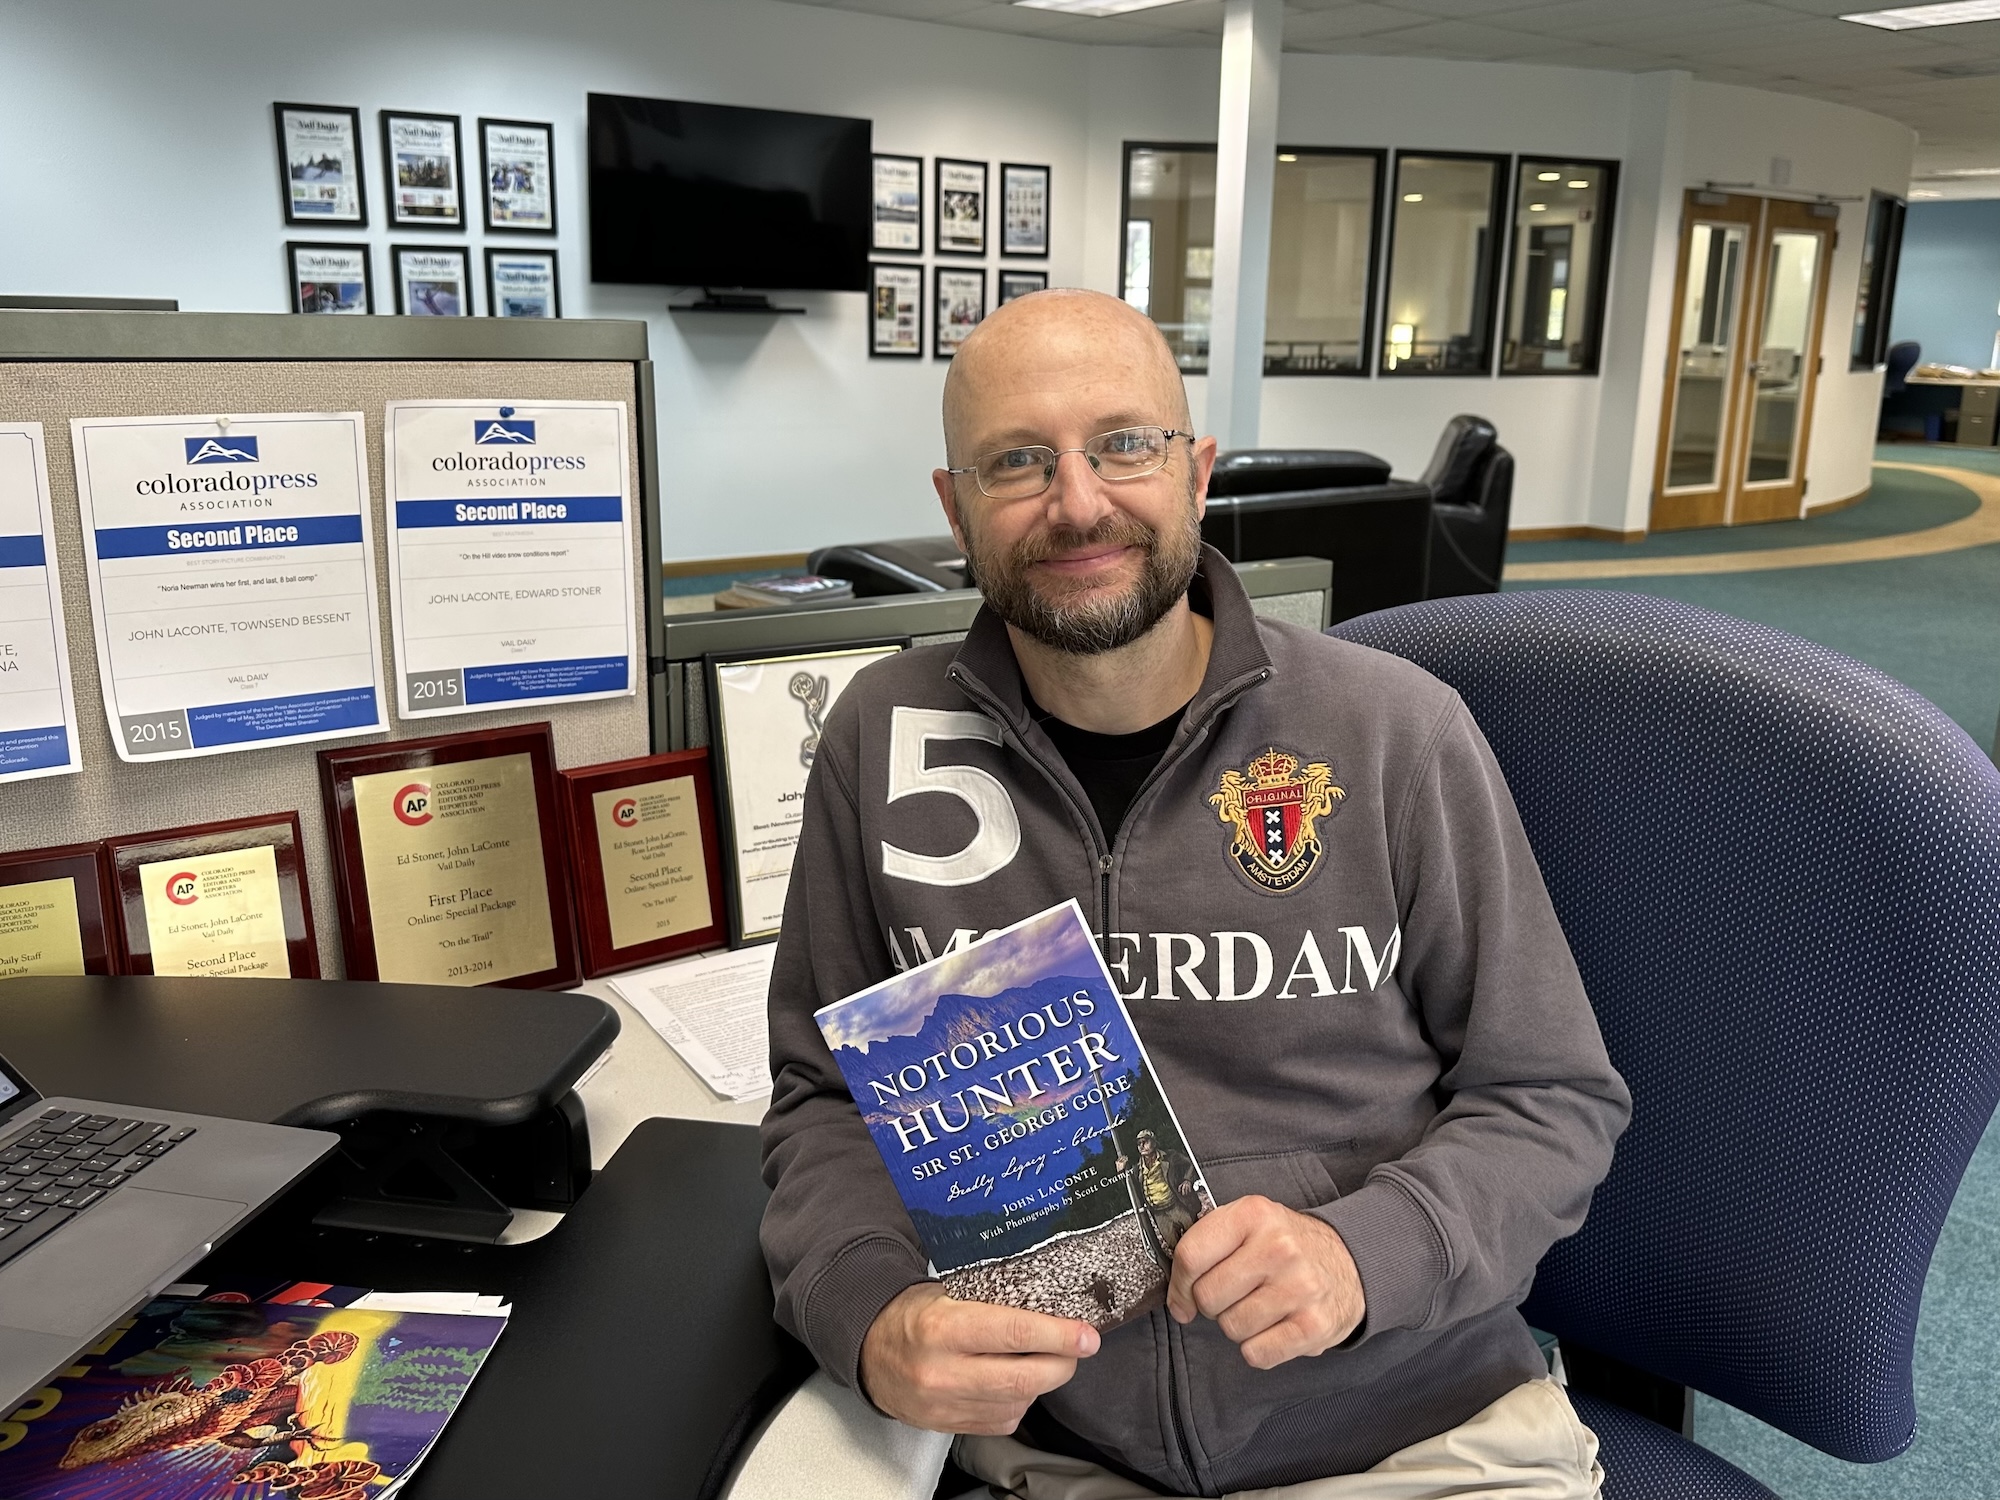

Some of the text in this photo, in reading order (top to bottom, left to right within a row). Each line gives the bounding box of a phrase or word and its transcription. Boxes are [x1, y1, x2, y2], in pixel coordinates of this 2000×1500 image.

[432, 451, 586, 475] coloradopress
[136, 471, 318, 496] coloradopress
[468, 478, 546, 487] ASSOCIATION
[180, 498, 273, 511] ASSOCIATION
[455, 502, 567, 521] Second Place
[167, 525, 298, 549] Second Place
[286, 575, 296, 583] ball
[428, 586, 601, 605] JOHN LACONTE, EDWARD STONER
[128, 612, 351, 642] JOHN LACONTE, TOWNSEND BESSENT
[228, 673, 269, 684] VAIL DAILY
[414, 679, 457, 699] 2015
[130, 721, 181, 743] 2015
[436, 779, 475, 789] COLORADO
[438, 782, 501, 796] ASSOCIATED PRESS
[438, 794, 468, 804] EDITORS
[880, 705, 1022, 887] 5
[1246, 790, 1303, 804] ORIGINAL
[406, 798, 427, 813] AP
[439, 800, 478, 811] REPORTERS
[441, 806, 485, 819] ASSOCIATION
[621, 808, 634, 819] AP
[614, 841, 622, 850] Ed
[646, 835, 659, 844] John
[397, 840, 510, 865] Ed Stoner, John LaConte
[201, 867, 234, 876] COLORADO
[438, 858, 476, 871] Vail Daily
[1247, 858, 1309, 886] AMSTERDAM
[202, 872, 238, 882] ASSOCIATED
[630, 866, 682, 883] Second Place
[177, 883, 194, 895] AP
[203, 879, 228, 887] EDITORS
[204, 884, 236, 893] REPORTERS
[648, 878, 669, 890] Special
[671, 875, 693, 884] Package
[205, 889, 242, 899] ASSOCIATION
[429, 887, 493, 907] First Place
[407, 900, 517, 926] Online: Special Package
[168, 925, 179, 934] Ed
[210, 918, 229, 928] John
[230, 913, 263, 923] LaConte
[202, 927, 234, 938] Vail Daily
[457, 937, 470, 946] the
[21, 951, 42, 962] Staff
[187, 951, 256, 970] Second Place
[889, 922, 1401, 1002] AMERDAM
[9, 966, 28, 975] Daily
[209, 966, 236, 977] Special
[238, 962, 269, 972] Package
[448, 960, 493, 977] 2013-2014
[867, 989, 1095, 1106] NOTORIOUS
[887, 1032, 1121, 1154] HUNTER
[911, 1075, 1131, 1181] SIR ST. GEORGE GORE
[947, 1114, 1127, 1202] Deadly Legacy in Colorado
[979, 1167, 1134, 1241] With Photography by Scott Cramer
[1002, 1194, 1035, 1217] JOHN
